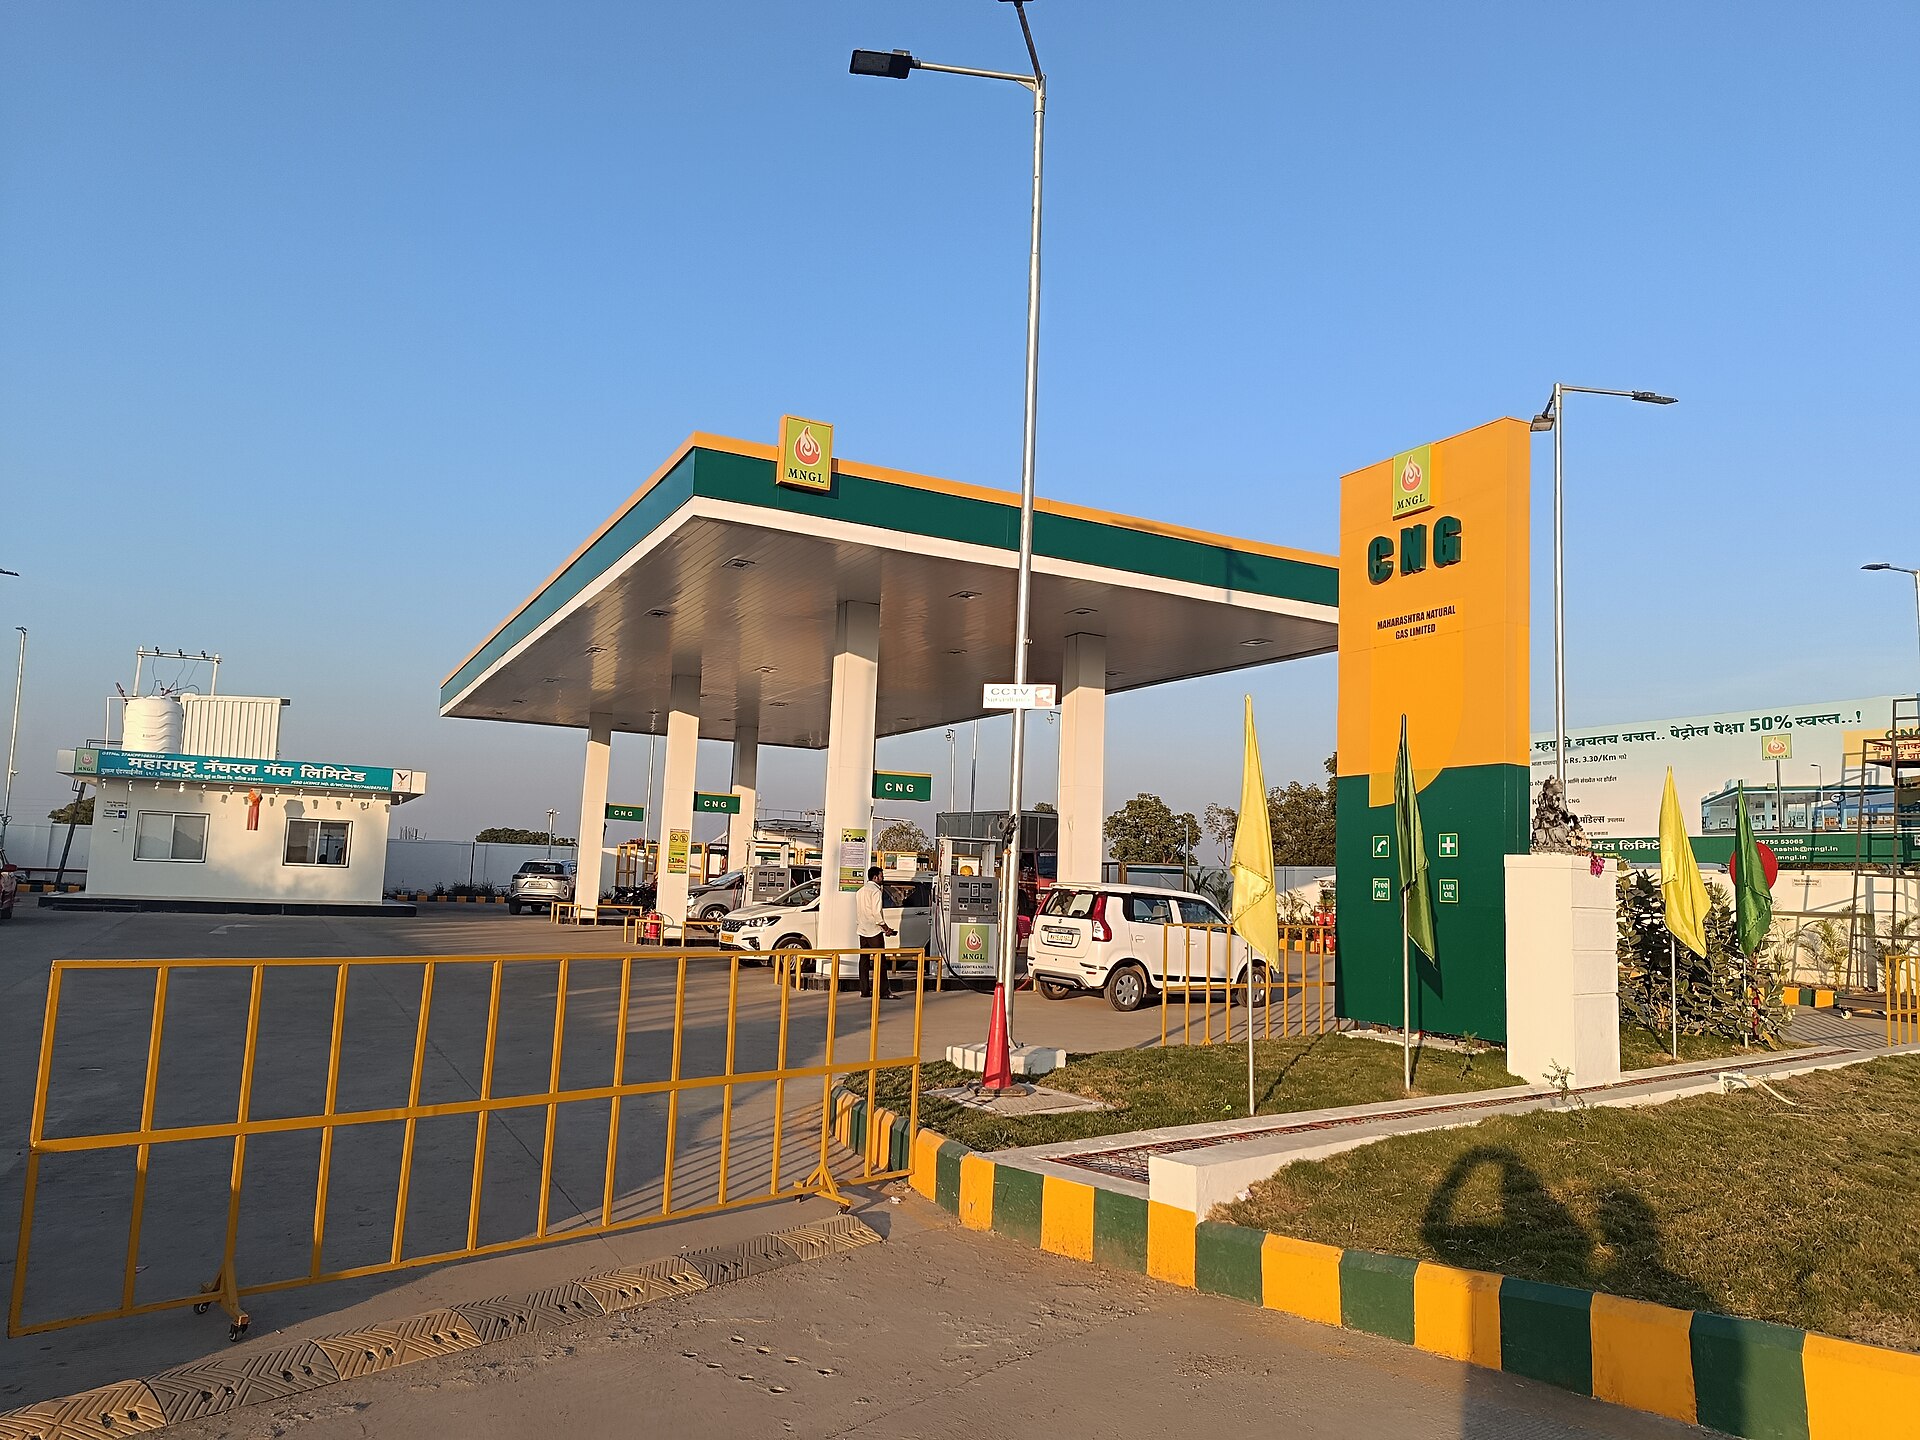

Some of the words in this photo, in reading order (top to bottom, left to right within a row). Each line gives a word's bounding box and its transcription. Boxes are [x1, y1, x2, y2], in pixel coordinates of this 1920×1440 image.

[788, 468, 825, 484] MNGL
[1396, 493, 1426, 511] MNGL
[1367, 515, 1463, 586] CNG
[1376, 611, 1425, 630] MAHARASHTRA
[1425, 605, 1456, 621] NATURAL
[1395, 628, 1409, 640] GAS
[1409, 623, 1436, 637] LIMITED
[991, 688, 1029, 696] CCTV
[1575, 734, 1619, 747] बचतच
[1669, 724, 1710, 741] पेट्रोल
[1713, 721, 1745, 736] पेक्षा
[1750, 714, 1793, 732] 50%
[1582, 754, 1617, 764] 3.30/Km
[128, 757, 198, 774] महाराष्ट्र
[203, 759, 259, 776] नॅचरल
[263, 762, 295, 778] गॅस
[299, 763, 367, 783] लिमिटेड
[885, 782, 914, 793] CNG
[703, 800, 727, 808] CNG
[614, 809, 633, 817] CNG
[1592, 840, 1615, 851] गॅस
[1619, 839, 1660, 850] लिमिटे
[1775, 854, 1807, 862] .mngl.in
[1374, 880, 1388, 889] Free
[1442, 883, 1455, 891] LUB
